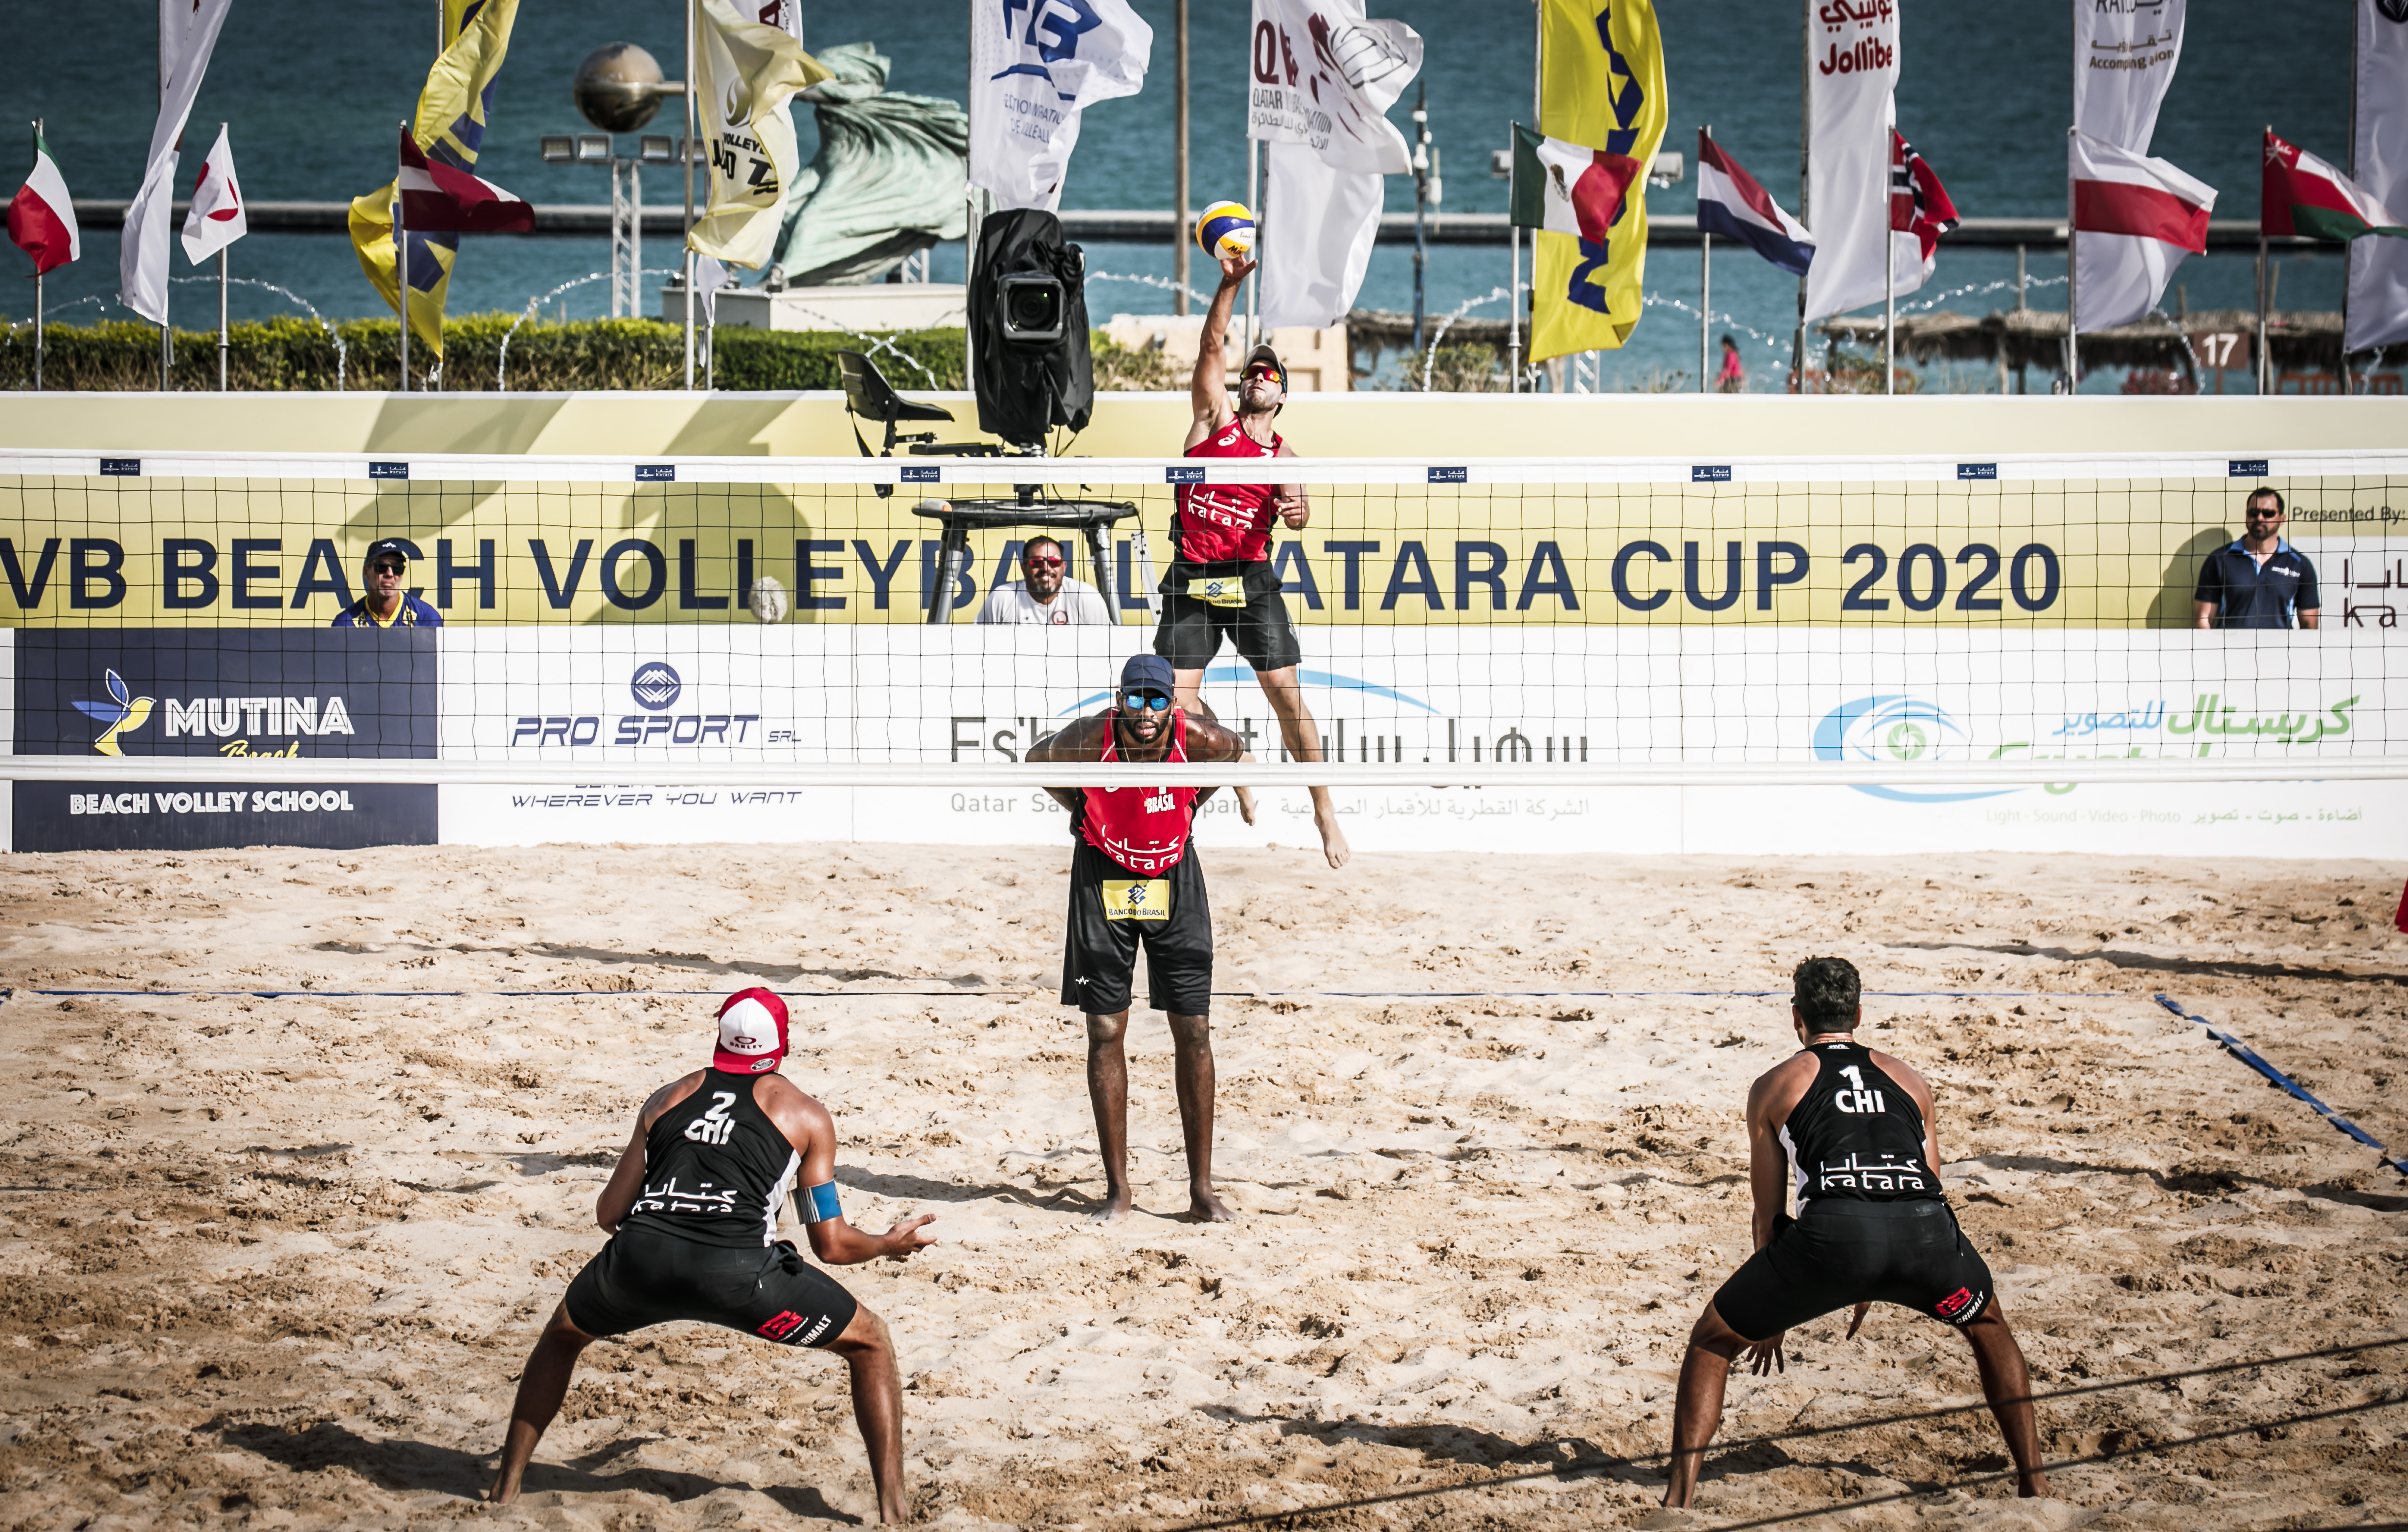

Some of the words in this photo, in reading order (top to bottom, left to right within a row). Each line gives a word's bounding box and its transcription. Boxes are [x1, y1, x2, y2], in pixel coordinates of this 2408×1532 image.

[1819, 35, 1892, 75] Jollibe
[723, 132, 765, 155] VOLLEY
[2203, 333, 2238, 367] 17
[2293, 506, 2374, 521] Presented
[2381, 506, 2406, 525] By:
[1272, 540, 1581, 610] ATARA
[1611, 540, 1811, 610] CUP
[1842, 543, 2061, 611] 2020
[165, 697, 355, 737] MUTINA
[2052, 700, 2165, 736] للتصوير
[2168, 694, 2360, 744] كريستال
[512, 717, 599, 746] PRO
[614, 715, 759, 744] SPORT
[768, 730, 802, 743] SRL
[70, 794, 150, 814] BEACH
[155, 791, 248, 813] VOLLEY
[252, 790, 354, 812] SCHOOL
[512, 794, 653, 808] WHEREVER
[666, 793, 717, 805] YOU
[731, 791, 802, 804] WANT
[951, 793, 1017, 812] Qatar
[1146, 793, 1176, 813] BRASIL
[1281, 798, 1367, 816] الصعية
[1375, 793, 1440, 819] للأقمار
[1447, 798, 1518, 820] القطرية
[1526, 799, 1589, 820] الشركة
[1986, 809, 2021, 825] Light
[2033, 809, 2077, 823] Sound
[2089, 809, 2128, 823] Video
[2140, 809, 2181, 823] Photo
[2191, 808, 2239, 824] تصوير
[2257, 808, 2299, 824] صوت
[1839, 1065, 1864, 1090] 1
[704, 1091, 737, 1121] 2
[1834, 1089, 1886, 1114] CHI
[684, 1119, 736, 1145] CHI
[1821, 1171, 1925, 1190] katara
[631, 1200, 732, 1215] katara
[1956, 1290, 1984, 1324] GRIMALT
[795, 1314, 832, 1347] GRIMALT
